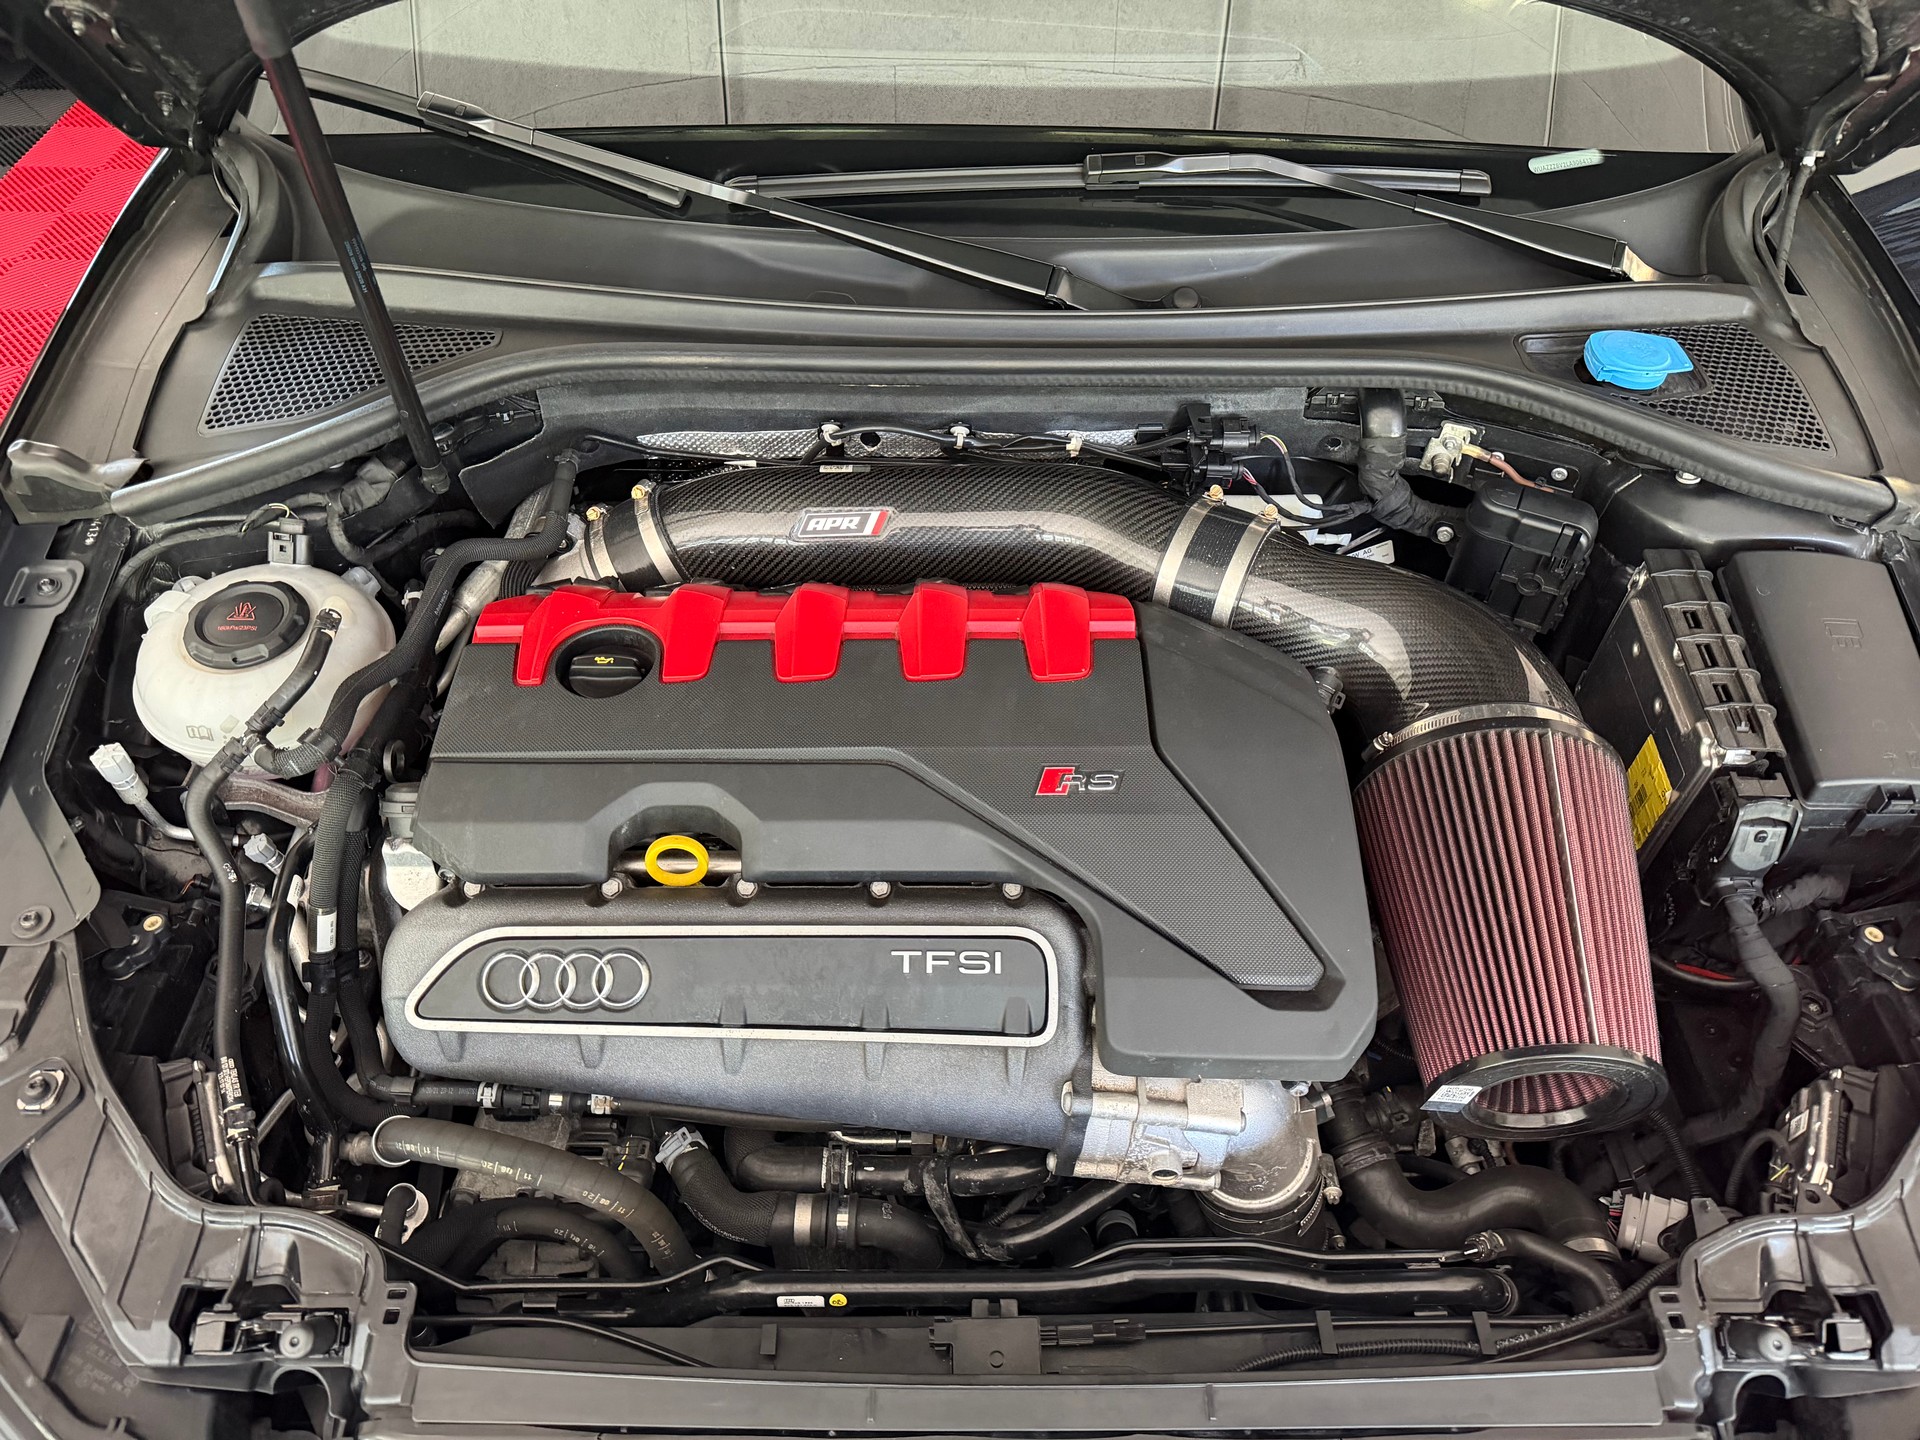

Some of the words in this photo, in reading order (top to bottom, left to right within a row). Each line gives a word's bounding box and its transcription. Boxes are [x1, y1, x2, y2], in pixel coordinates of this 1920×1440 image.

[805, 516, 861, 531] APR
[1039, 769, 1119, 793] RS
[890, 950, 1002, 975] TFSI
